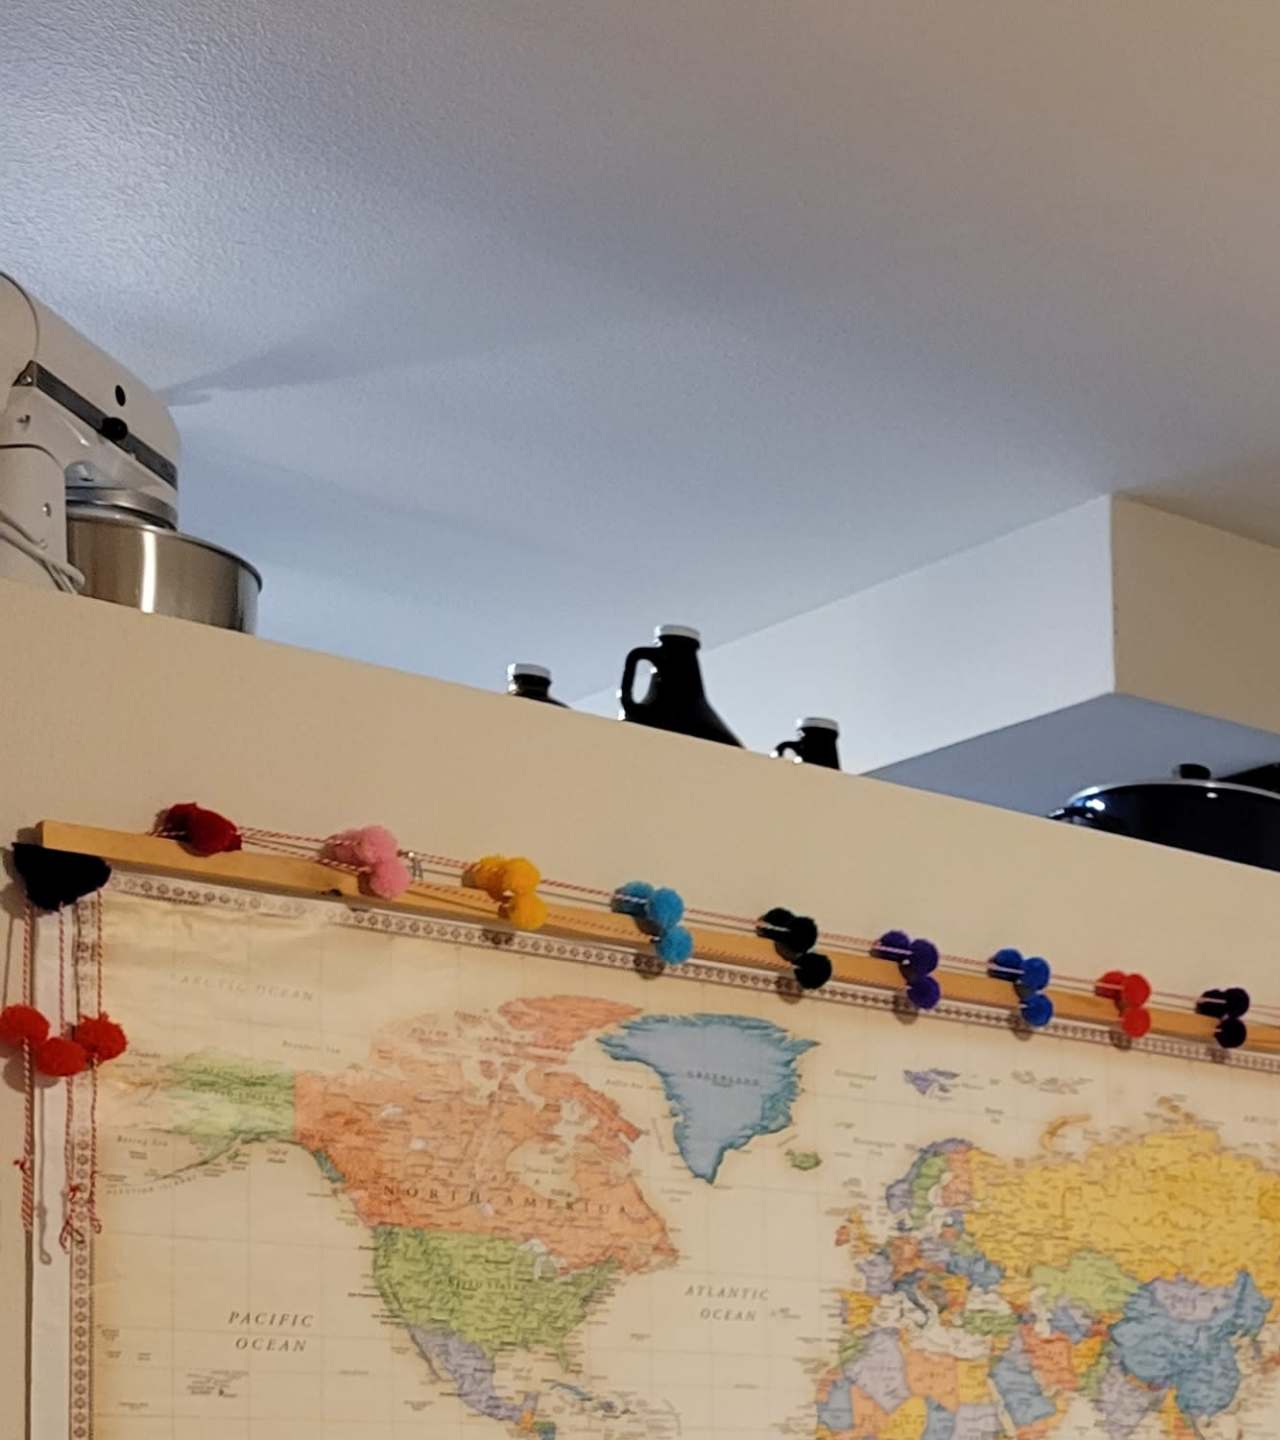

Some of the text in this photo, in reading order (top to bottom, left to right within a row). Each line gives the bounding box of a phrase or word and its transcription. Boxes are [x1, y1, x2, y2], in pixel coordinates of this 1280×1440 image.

[383, 1184, 480, 1204] NORTH
[685, 1284, 769, 1302] ATLANTIC
[228, 1311, 314, 1328] PACIFIC
[700, 1307, 756, 1322] OCEAN
[235, 1337, 308, 1353] OCEAN
